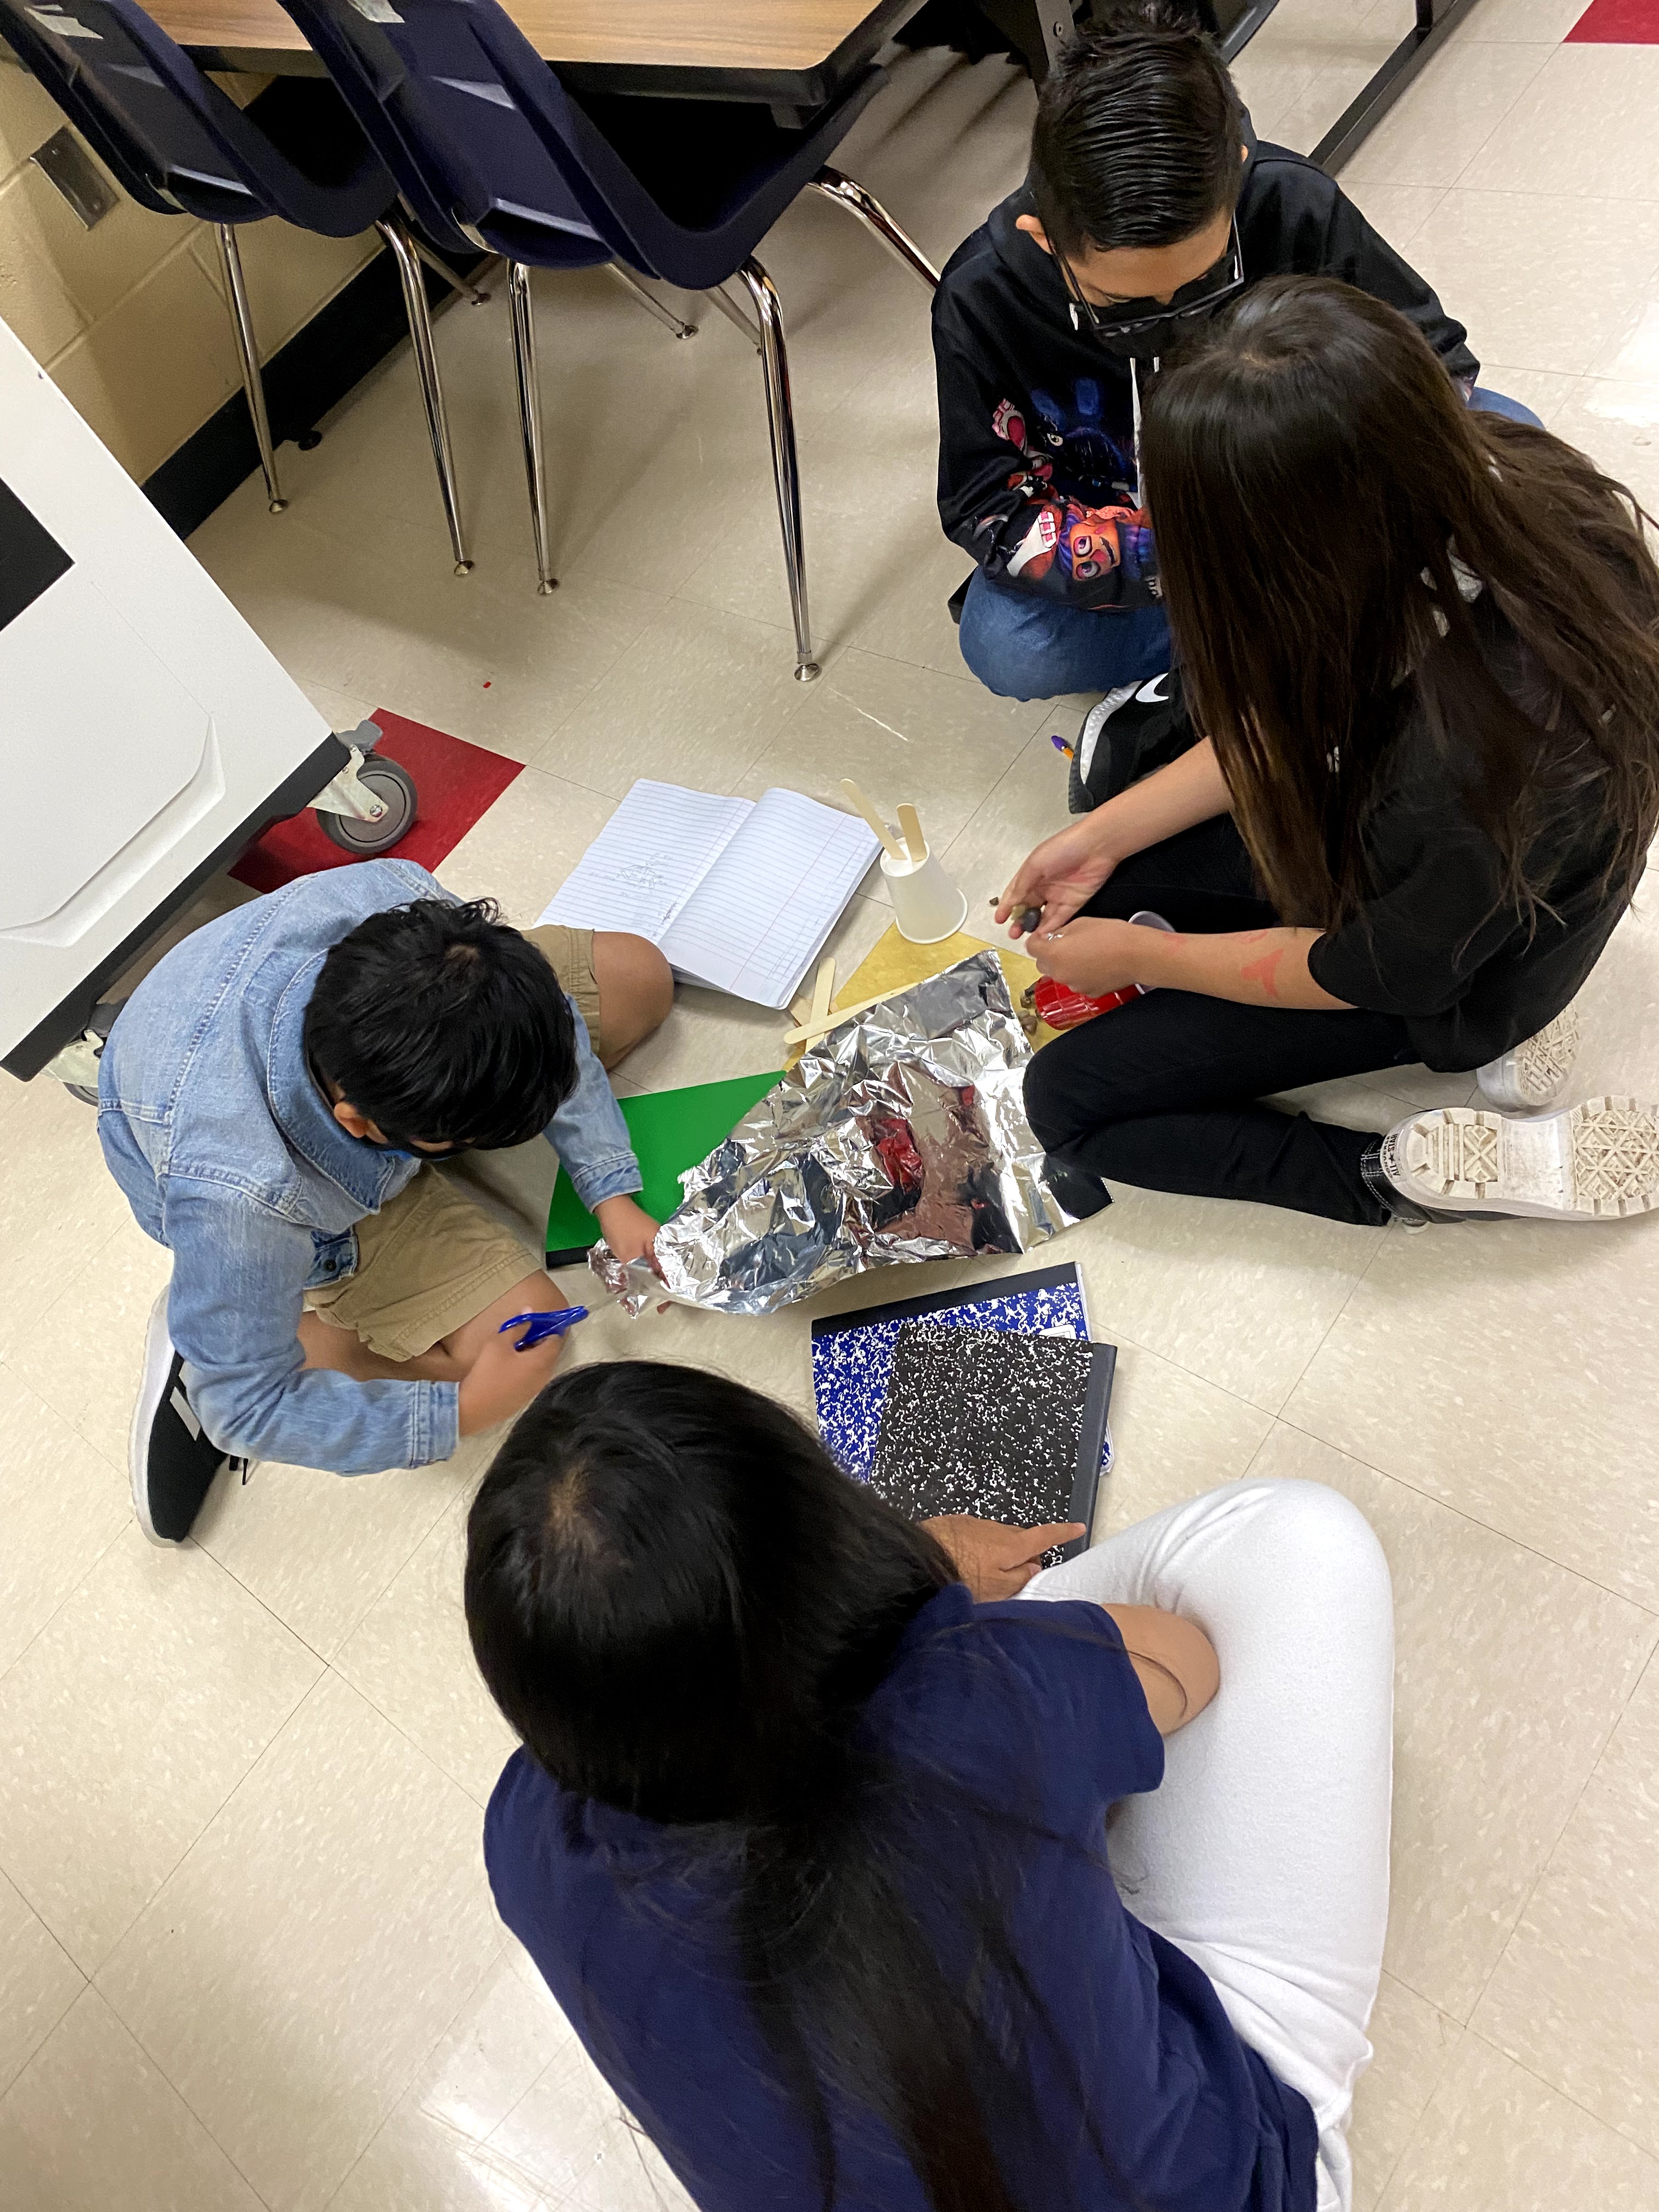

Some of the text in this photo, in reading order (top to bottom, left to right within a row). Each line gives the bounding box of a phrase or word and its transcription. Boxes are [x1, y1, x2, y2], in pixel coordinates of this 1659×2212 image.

[1383, 1136, 1392, 1178] CONVERSE
[1387, 1133, 1401, 1176] ALL STAR
